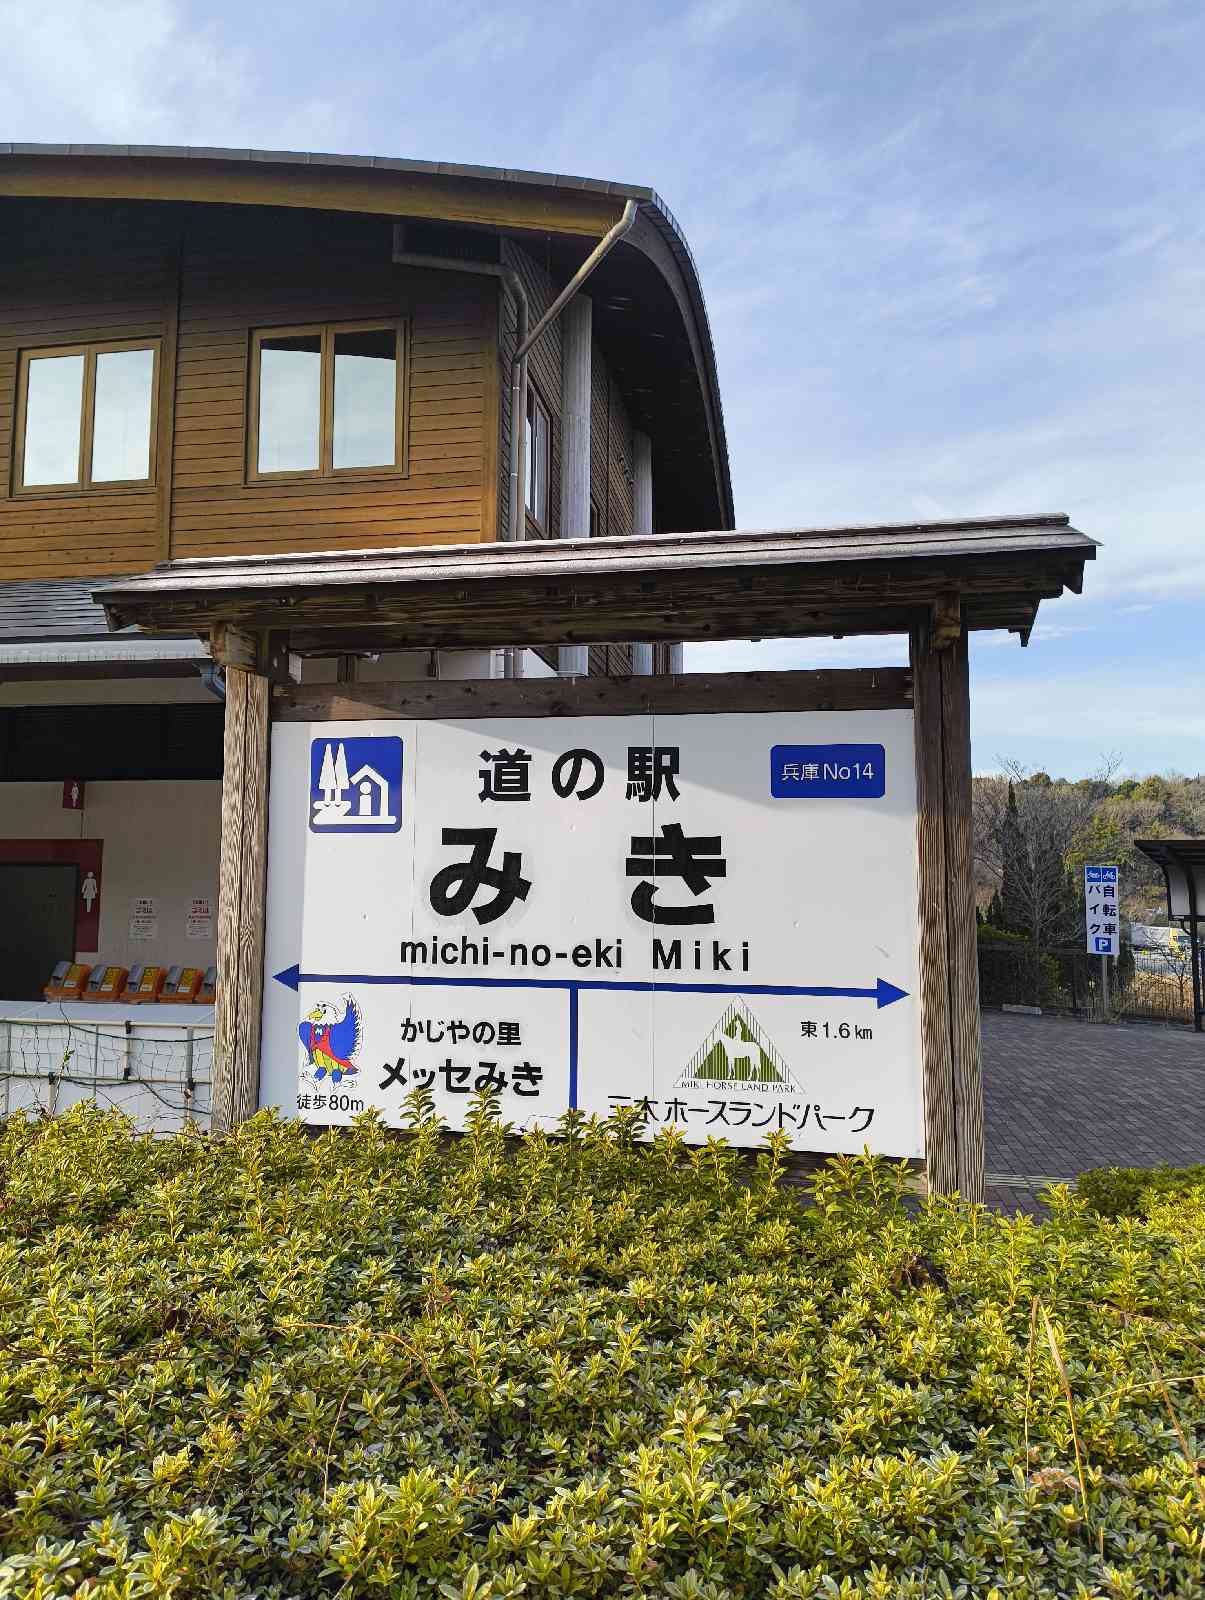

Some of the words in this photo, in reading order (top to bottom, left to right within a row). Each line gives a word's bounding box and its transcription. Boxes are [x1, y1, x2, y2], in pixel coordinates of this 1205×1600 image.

[477, 746, 680, 804] 道の駅
[429, 823, 727, 925] みき
[1088, 884, 1101, 935] バイク
[1102, 885, 1117, 936] 自転車
[400, 936, 622, 969] michi-no-eki
[651, 939, 750, 972] Miki
[400, 1016, 522, 1046] かじやの里
[378, 1057, 543, 1097] メッセみき
[681, 1080, 703, 1089] MIK
[741, 1082, 769, 1093] LAND
[772, 1084, 796, 1094] PARK
[296, 1093, 364, 1112] 徒歩80m
[607, 1096, 875, 1133] 三木ホースランドパーク
